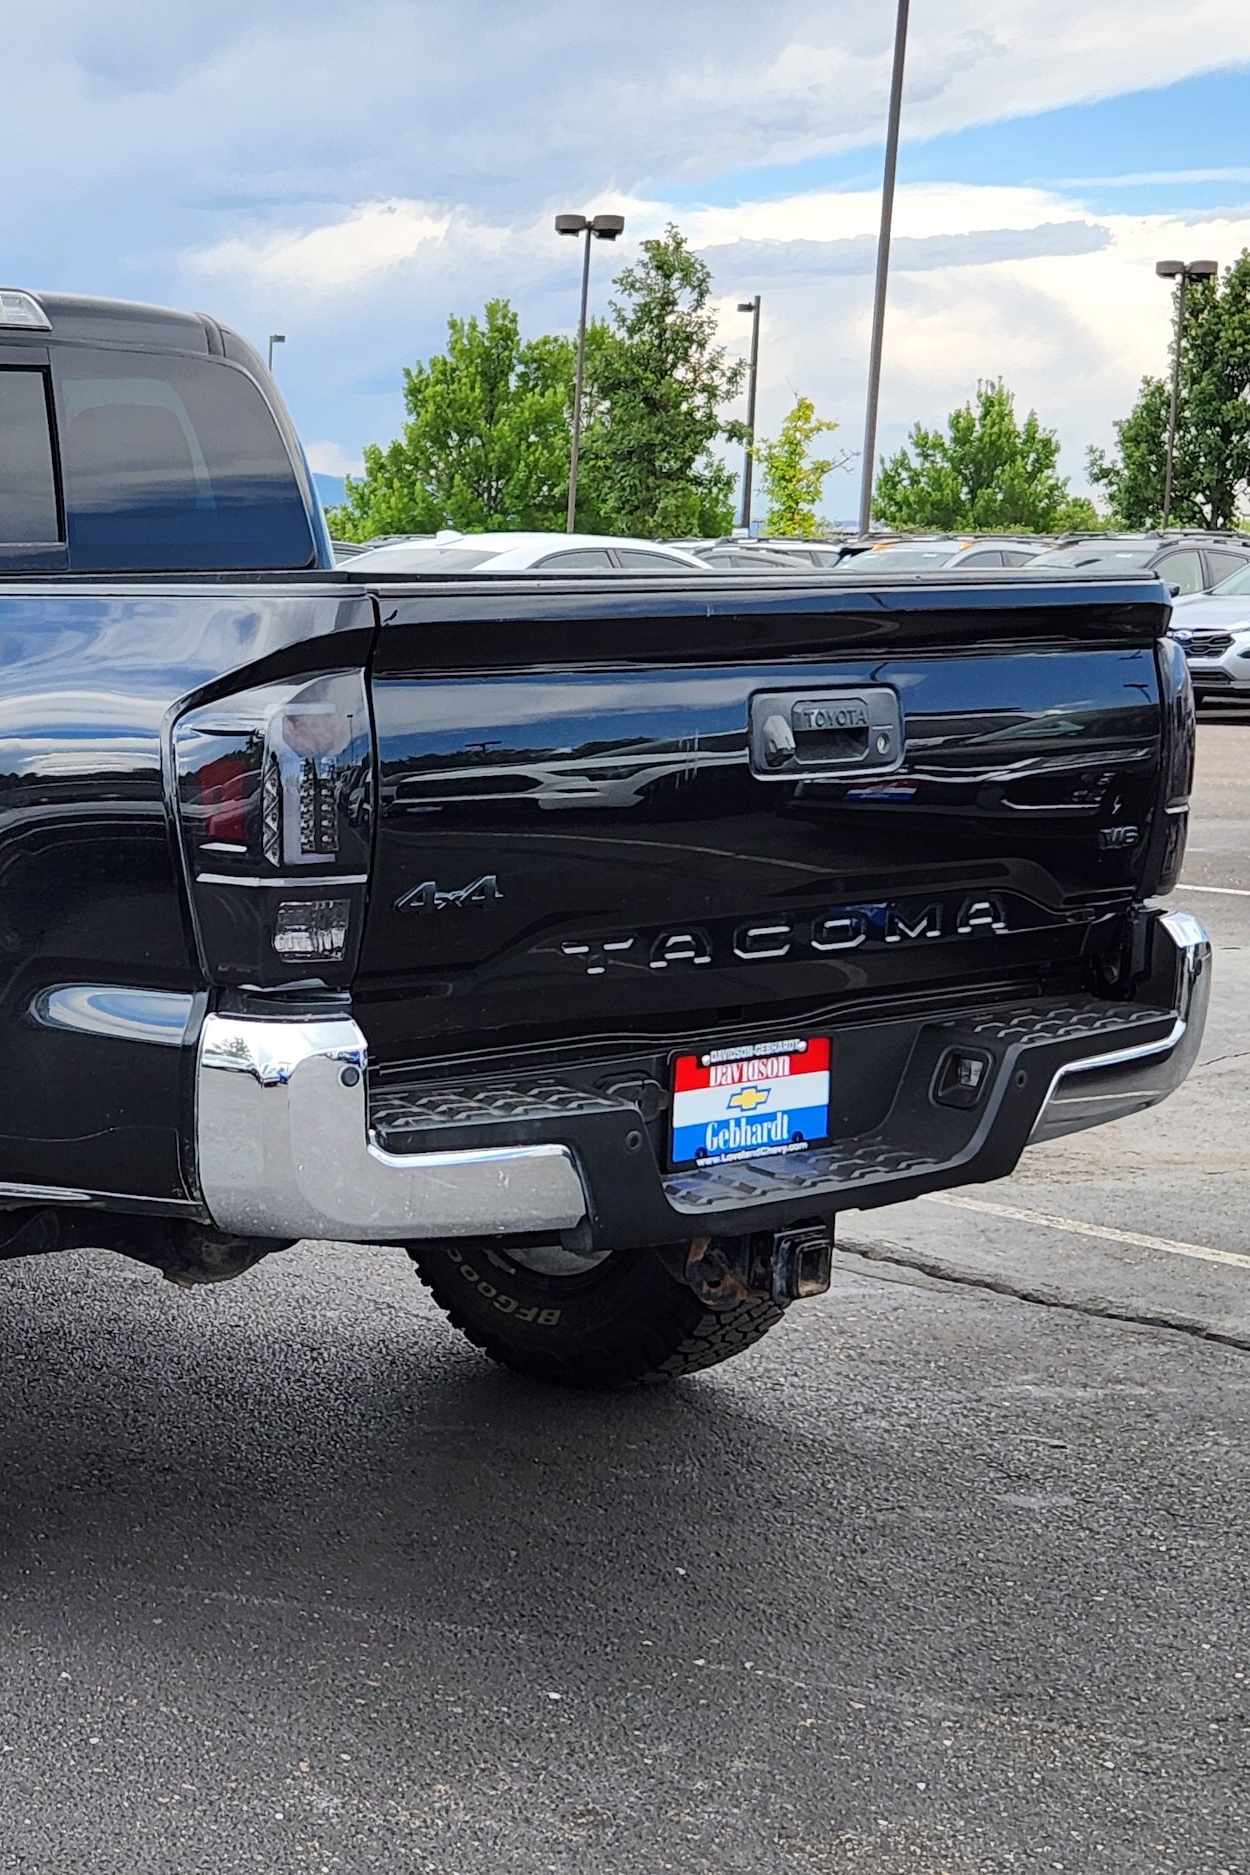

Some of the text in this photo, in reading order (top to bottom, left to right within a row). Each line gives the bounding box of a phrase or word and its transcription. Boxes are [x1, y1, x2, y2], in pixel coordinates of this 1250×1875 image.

[803, 709, 868, 728] TOYOTA
[560, 893, 1008, 976] TACOMA
[705, 1111, 789, 1151] Gebhardt
